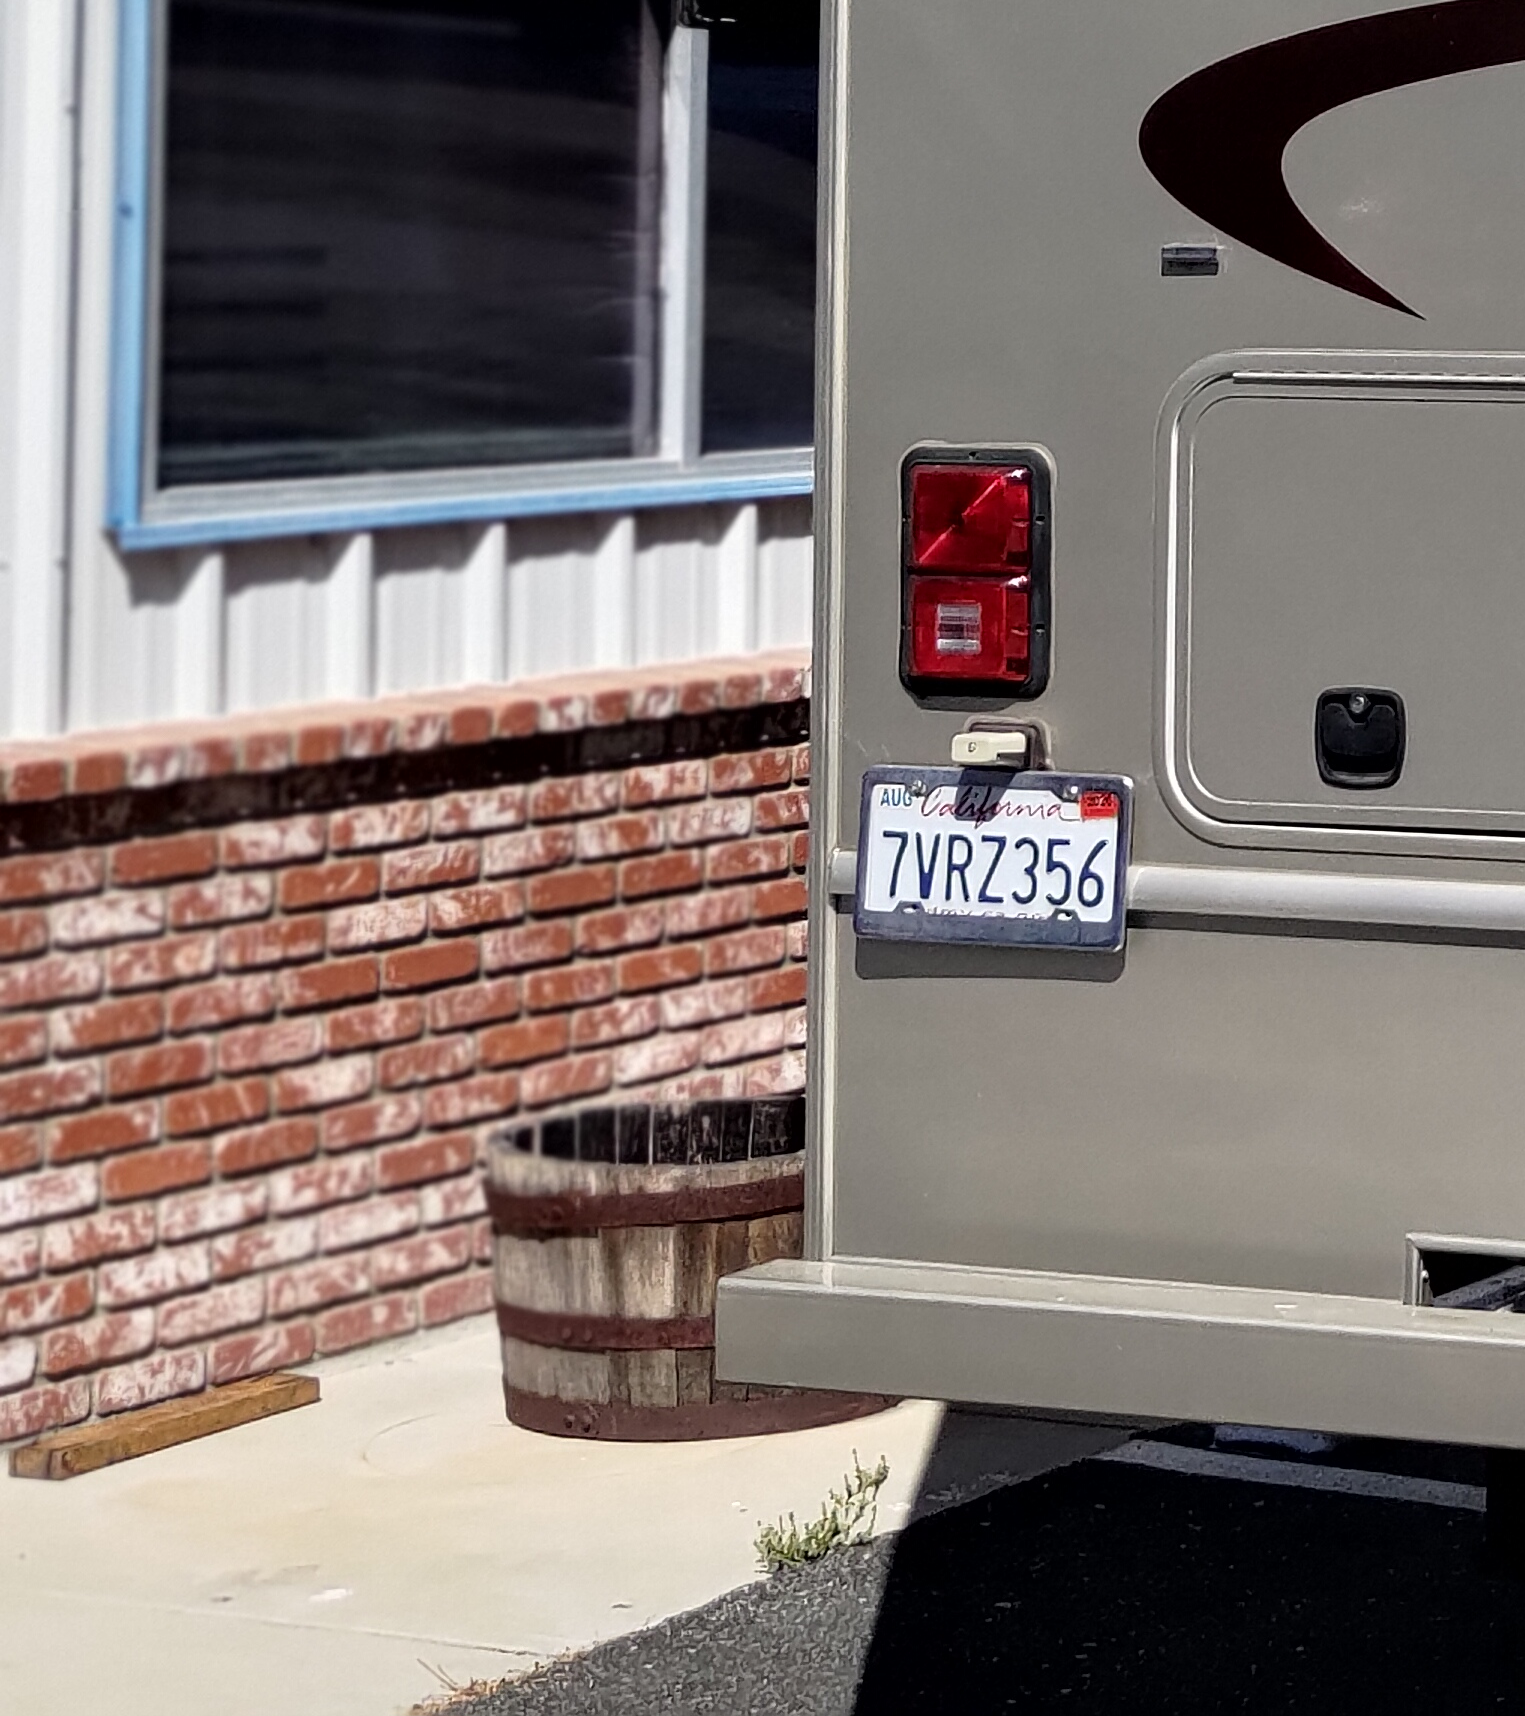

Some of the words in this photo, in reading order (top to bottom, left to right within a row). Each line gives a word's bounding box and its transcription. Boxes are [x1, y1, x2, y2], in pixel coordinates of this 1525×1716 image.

[880, 788, 912, 808] AUG
[921, 786, 1062, 829] California
[882, 830, 1109, 908] 7VRZ356
